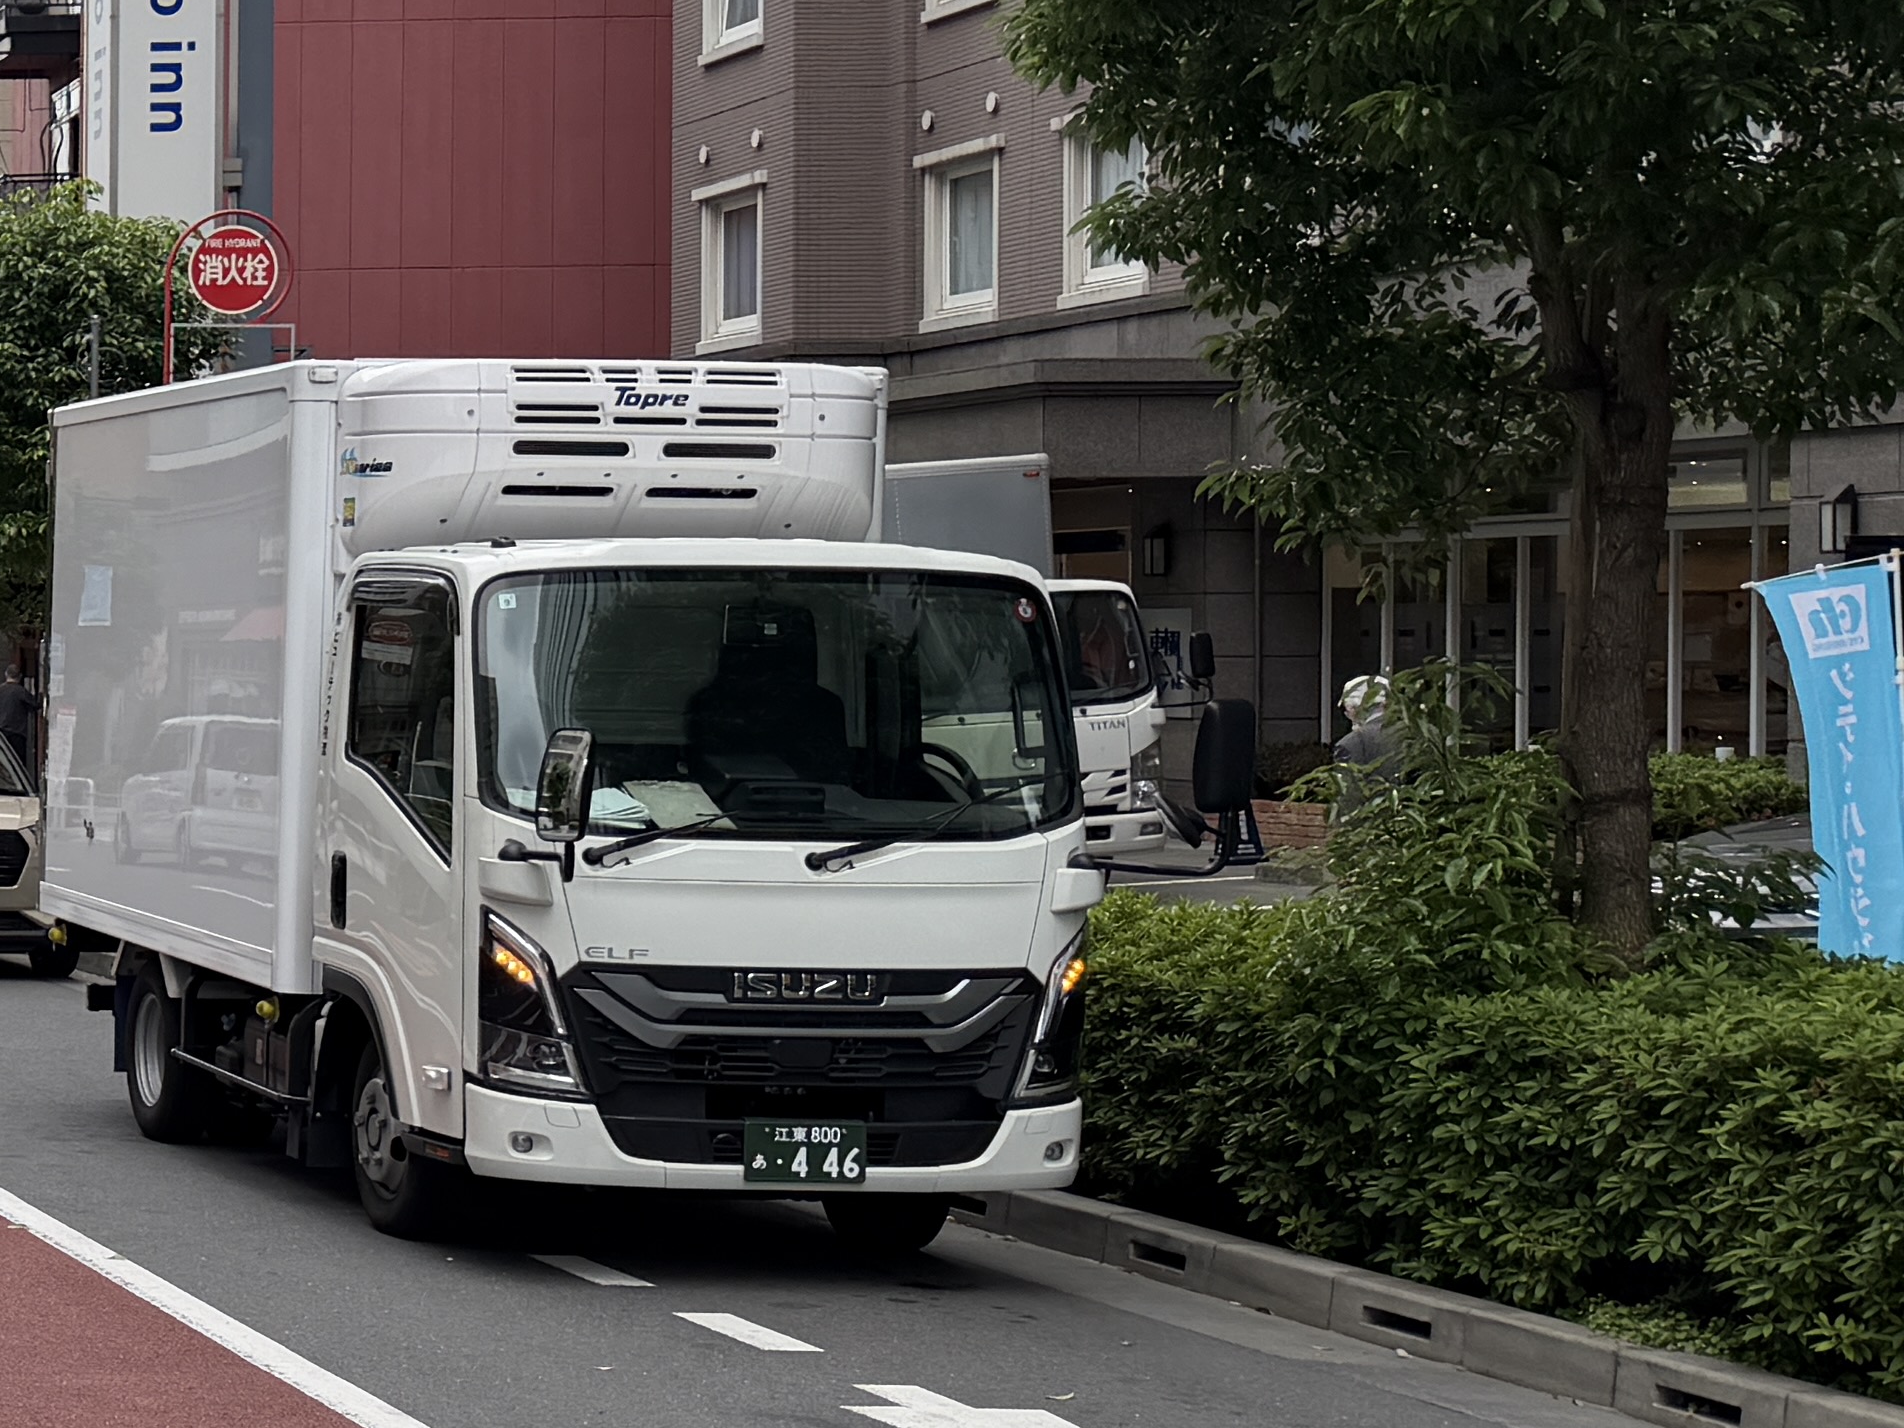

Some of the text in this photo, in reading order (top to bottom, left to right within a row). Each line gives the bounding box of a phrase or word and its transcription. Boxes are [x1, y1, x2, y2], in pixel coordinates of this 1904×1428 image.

[94, 46, 107, 141] inn
[149, 41, 196, 133] inn
[198, 253, 270, 286] 消火栓
[614, 386, 690, 410] Topre
[1089, 720, 1126, 731] TITAN
[584, 946, 649, 959] ELF
[733, 972, 876, 999] ISUZU
[774, 1126, 841, 1143] 江東 800
[752, 1153, 767, 1169] あ
